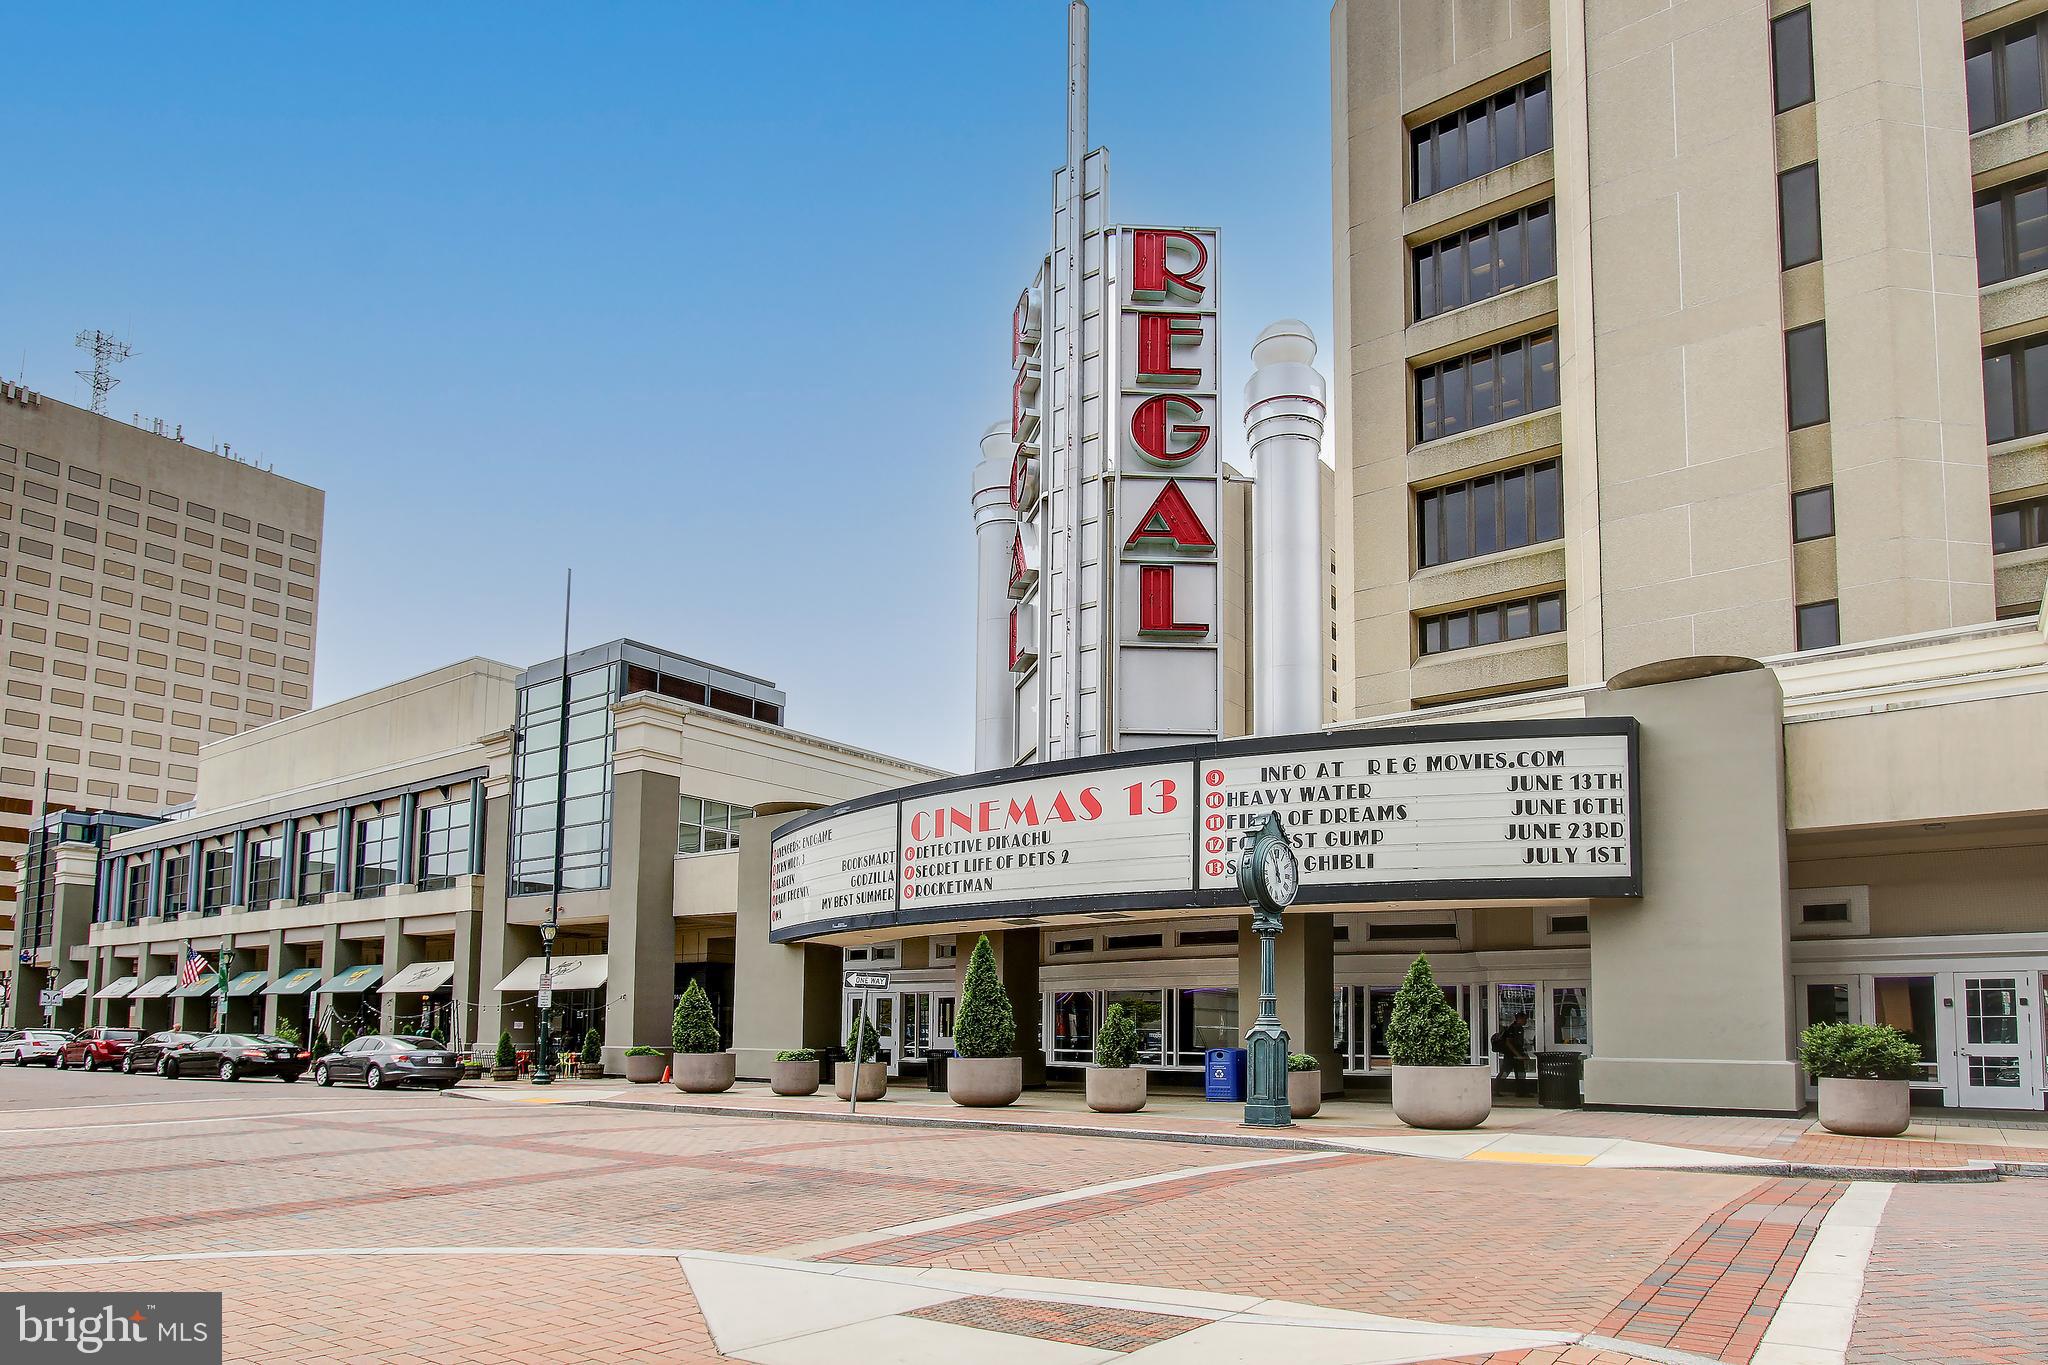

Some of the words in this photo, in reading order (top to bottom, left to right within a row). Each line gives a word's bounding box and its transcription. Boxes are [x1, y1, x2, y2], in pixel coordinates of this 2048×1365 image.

[1122, 228, 1218, 638] REGAL
[1261, 764, 1306, 783] INFO
[1316, 761, 1344, 778] AT
[1426, 750, 1565, 772] MOVIES.COM
[1506, 775, 1563, 792] JUNE
[1569, 773, 1623, 790] 13TH
[1227, 787, 1292, 807] HEAVY
[1300, 783, 1372, 803] WATER
[910, 786, 1103, 842] CINEMAS
[1122, 778, 1178, 816] 13
[1288, 810, 1314, 826] OF
[1320, 804, 1408, 824] DREAMS
[1511, 799, 1567, 815] JUNE
[1573, 798, 1624, 814] 16TH
[1325, 829, 1384, 847] GUMP
[1504, 823, 1562, 840] JUNE
[1568, 822, 1624, 839] 23RD
[916, 836, 983, 860] DETECTIVE
[987, 830, 1052, 850] PIKACHU
[1522, 847, 1578, 864] JULY
[1586, 846, 1625, 863] 1ST
[841, 850, 896, 872] BOOKSMART
[915, 858, 960, 879] SECRET
[964, 855, 993, 873] LIFE
[997, 853, 1014, 869] OF
[1019, 850, 1056, 867] PETS
[1061, 849, 1070, 864] 2
[1304, 853, 1375, 872] GHIBLI
[850, 869, 895, 888] GODZILLA
[915, 877, 994, 898] ROCKETMAN
[821, 897, 833, 910] MY
[834, 893, 854, 908] BEST
[856, 887, 895, 905] SUMMER
[856, 976, 869, 984] ONE
[870, 977, 885, 985] WAY
